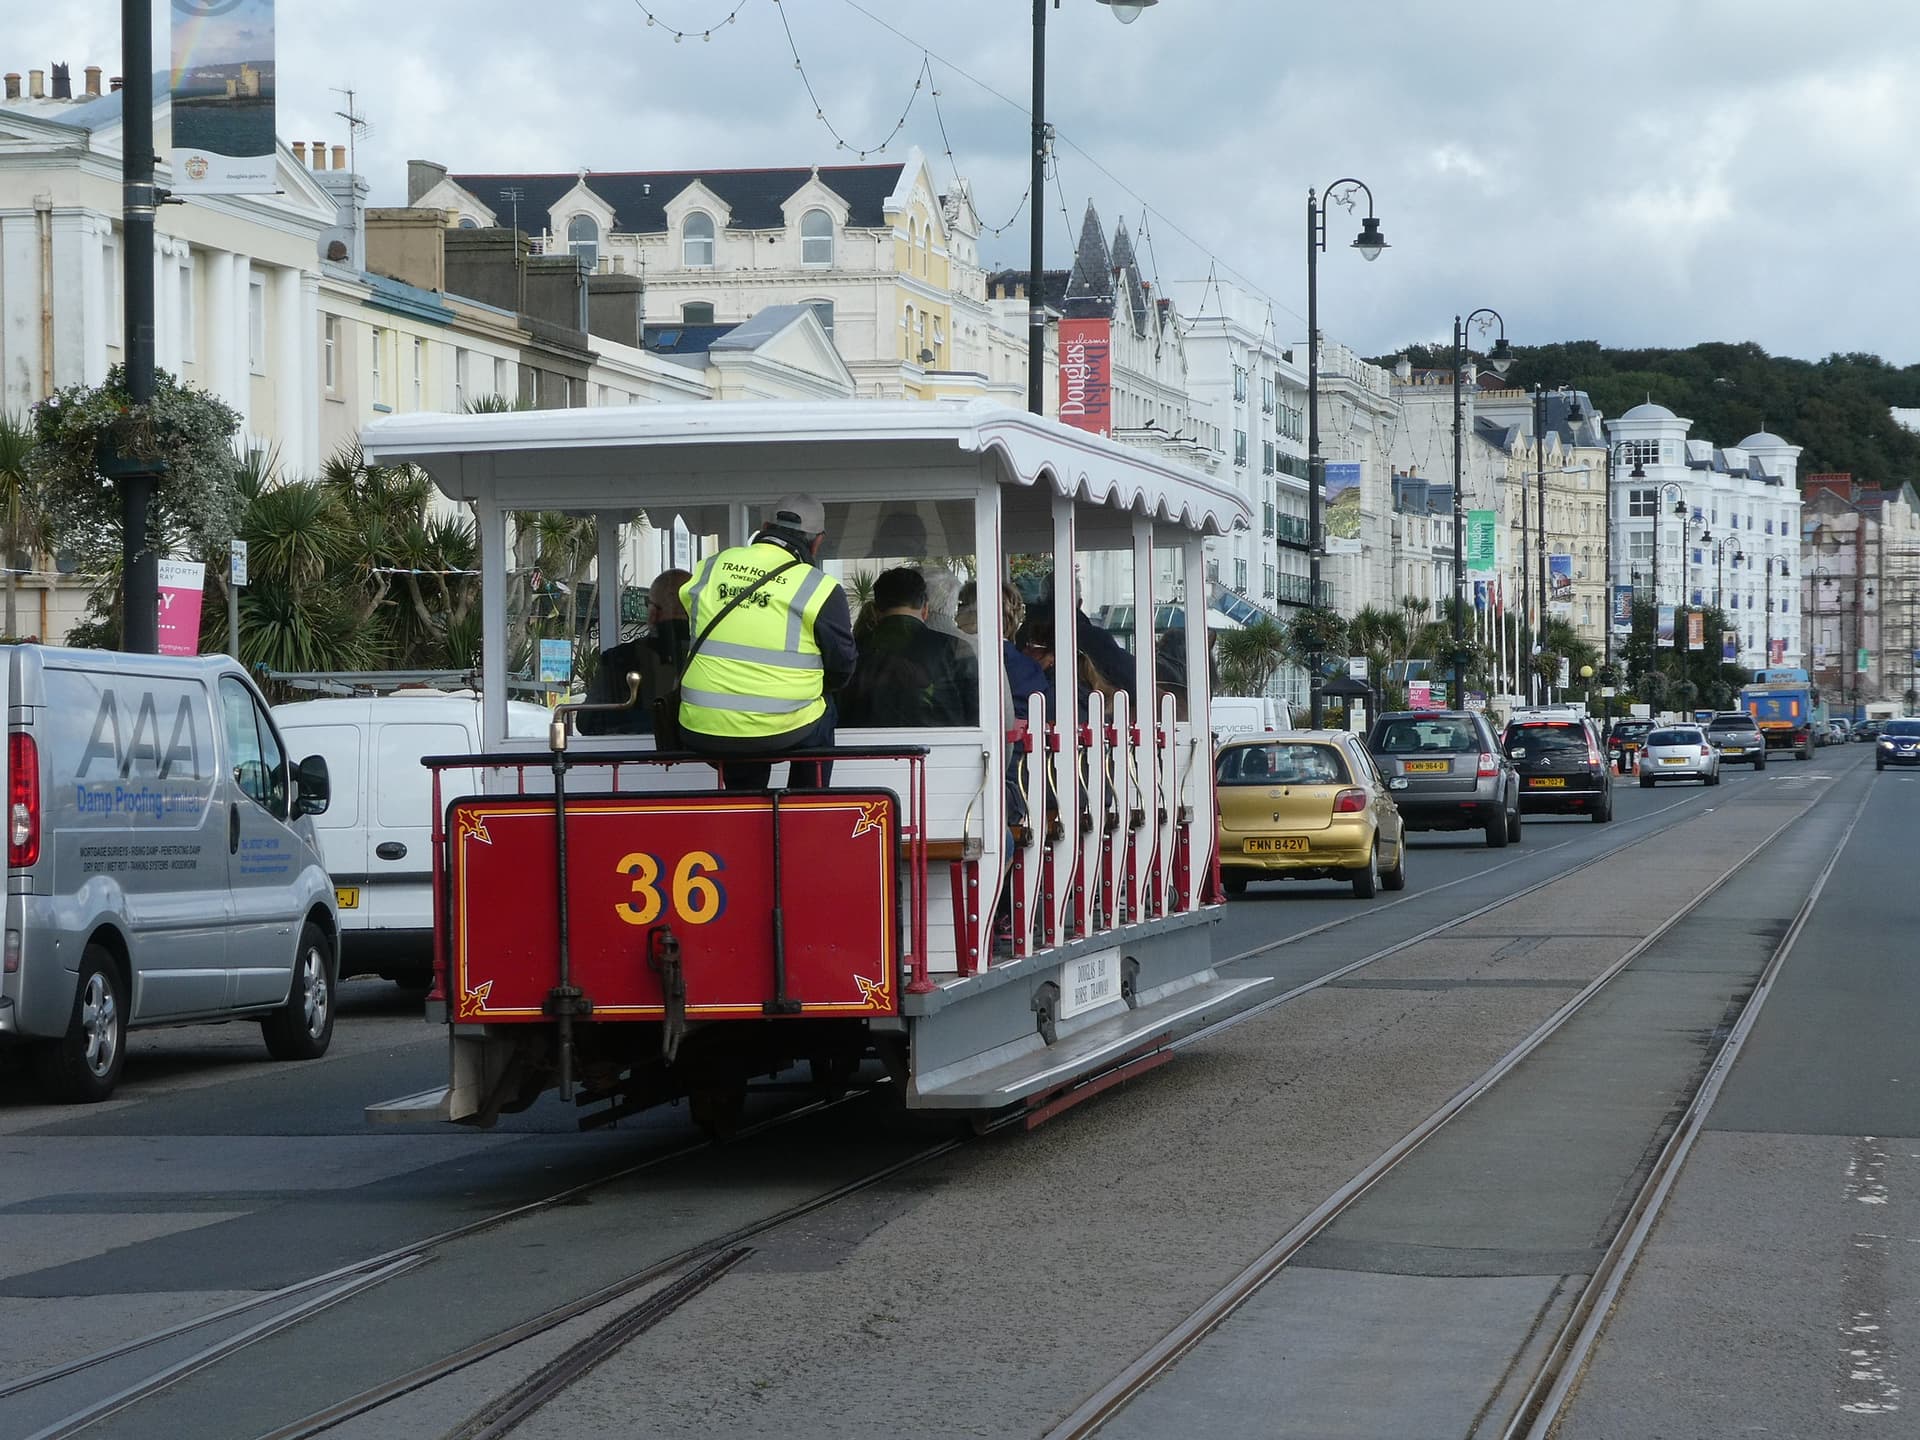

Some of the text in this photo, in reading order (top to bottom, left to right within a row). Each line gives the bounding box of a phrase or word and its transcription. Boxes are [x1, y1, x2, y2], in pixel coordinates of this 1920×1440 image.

[1060, 333, 1108, 344] welcome
[1060, 344, 1091, 415] Douglas
[159, 566, 198, 576] ARFORTH
[722, 562, 748, 573] TRAM
[75, 689, 200, 780] AAA
[77, 784, 200, 820] Damp Proofing Limited
[1249, 840, 1304, 850] FMN 842V
[615, 851, 726, 925] 36
